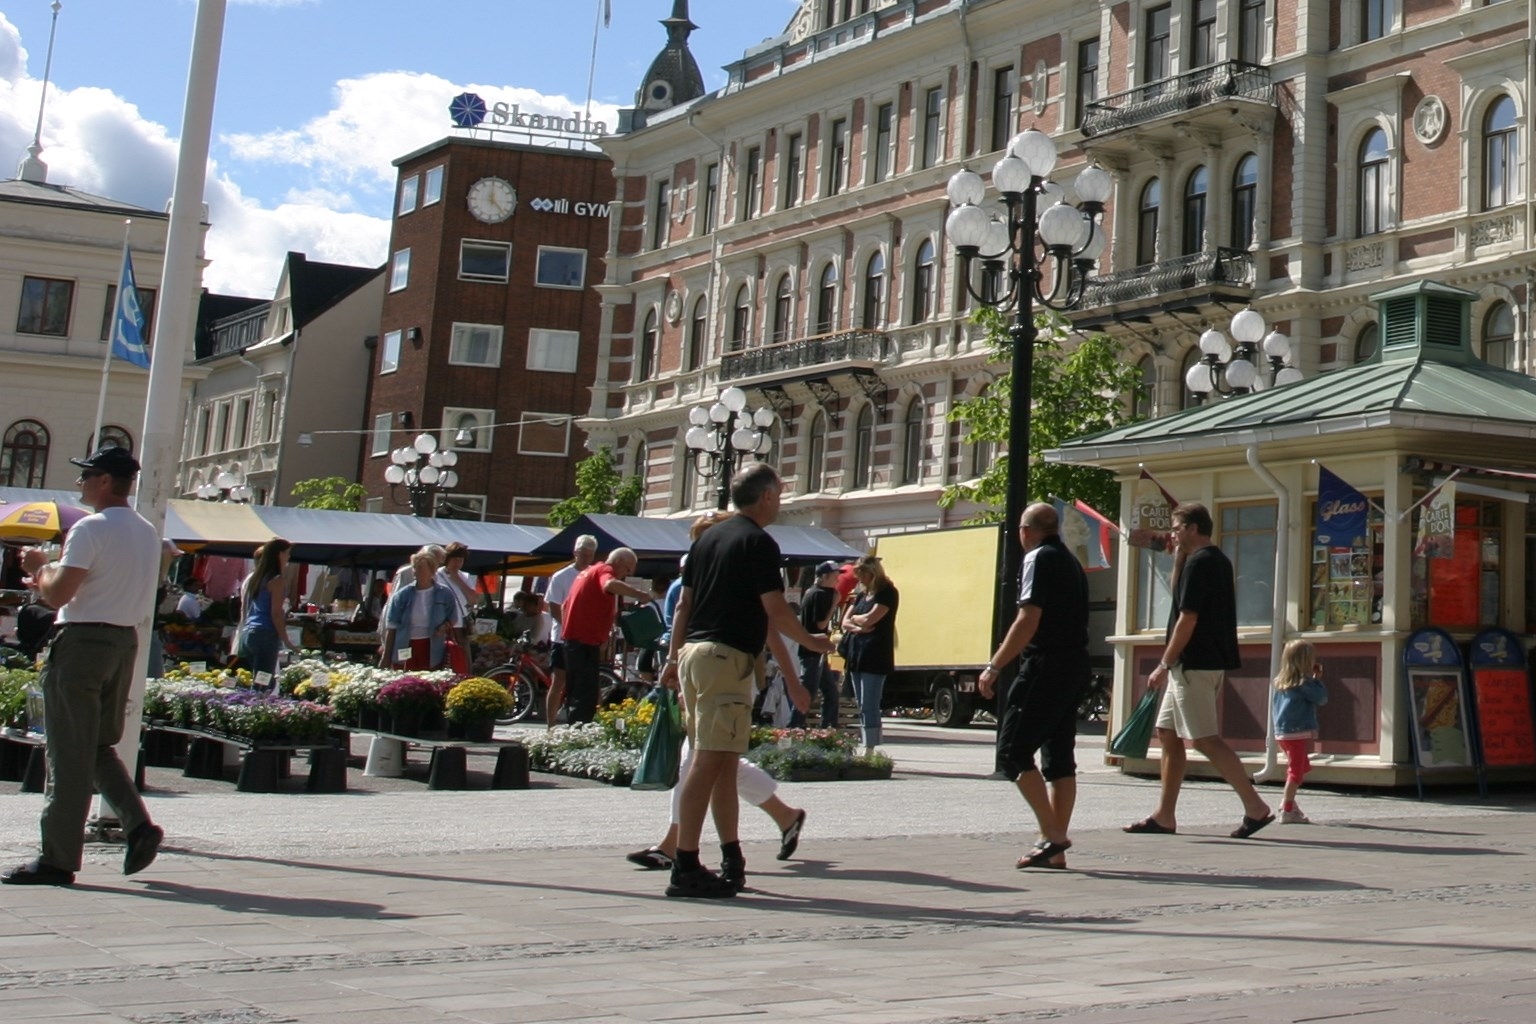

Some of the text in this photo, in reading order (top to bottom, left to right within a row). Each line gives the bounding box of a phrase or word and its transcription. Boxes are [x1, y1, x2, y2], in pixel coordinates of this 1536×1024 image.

[492, 101, 609, 136] Skandia
[574, 201, 611, 218] GYM
[1141, 505, 1170, 517] CARTE
[1425, 508, 1449, 523] CARTE
